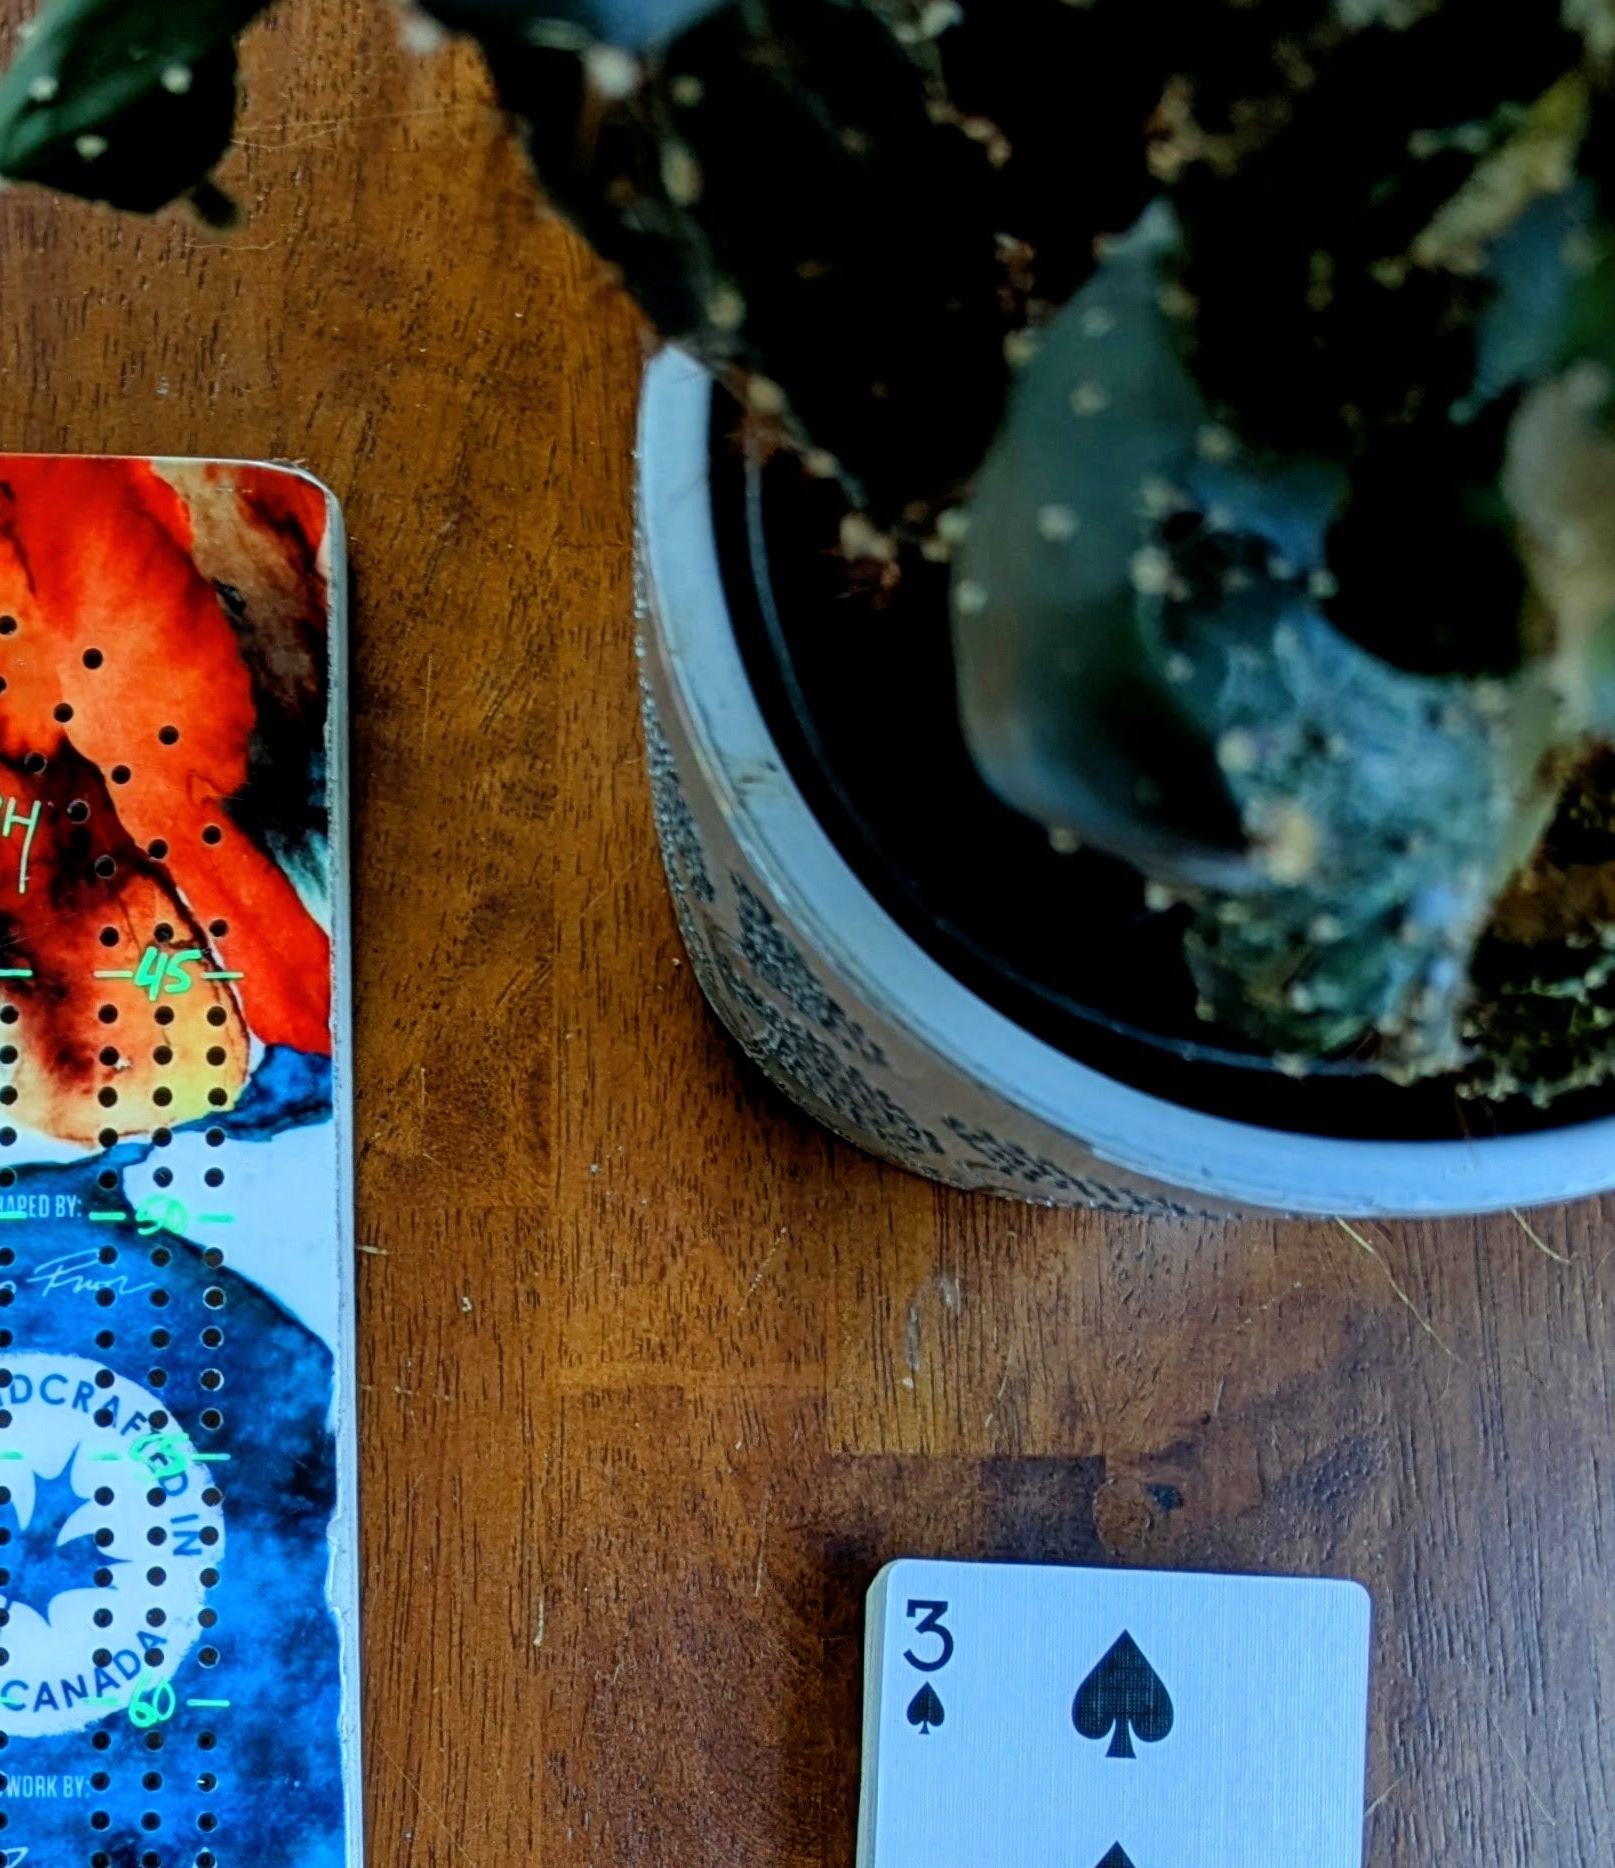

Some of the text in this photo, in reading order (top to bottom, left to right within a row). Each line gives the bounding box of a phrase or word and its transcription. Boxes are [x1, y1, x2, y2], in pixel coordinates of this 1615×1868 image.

[131, 947, 202, 1002] 45
[55, 1194, 82, 1218] BY:
[134, 1193, 186, 1237] 50
[170, 1513, 203, 1557] IN
[902, 1598, 955, 1673] 3
[0, 1630, 168, 1712] CANADA
[128, 1670, 176, 1728] 60
